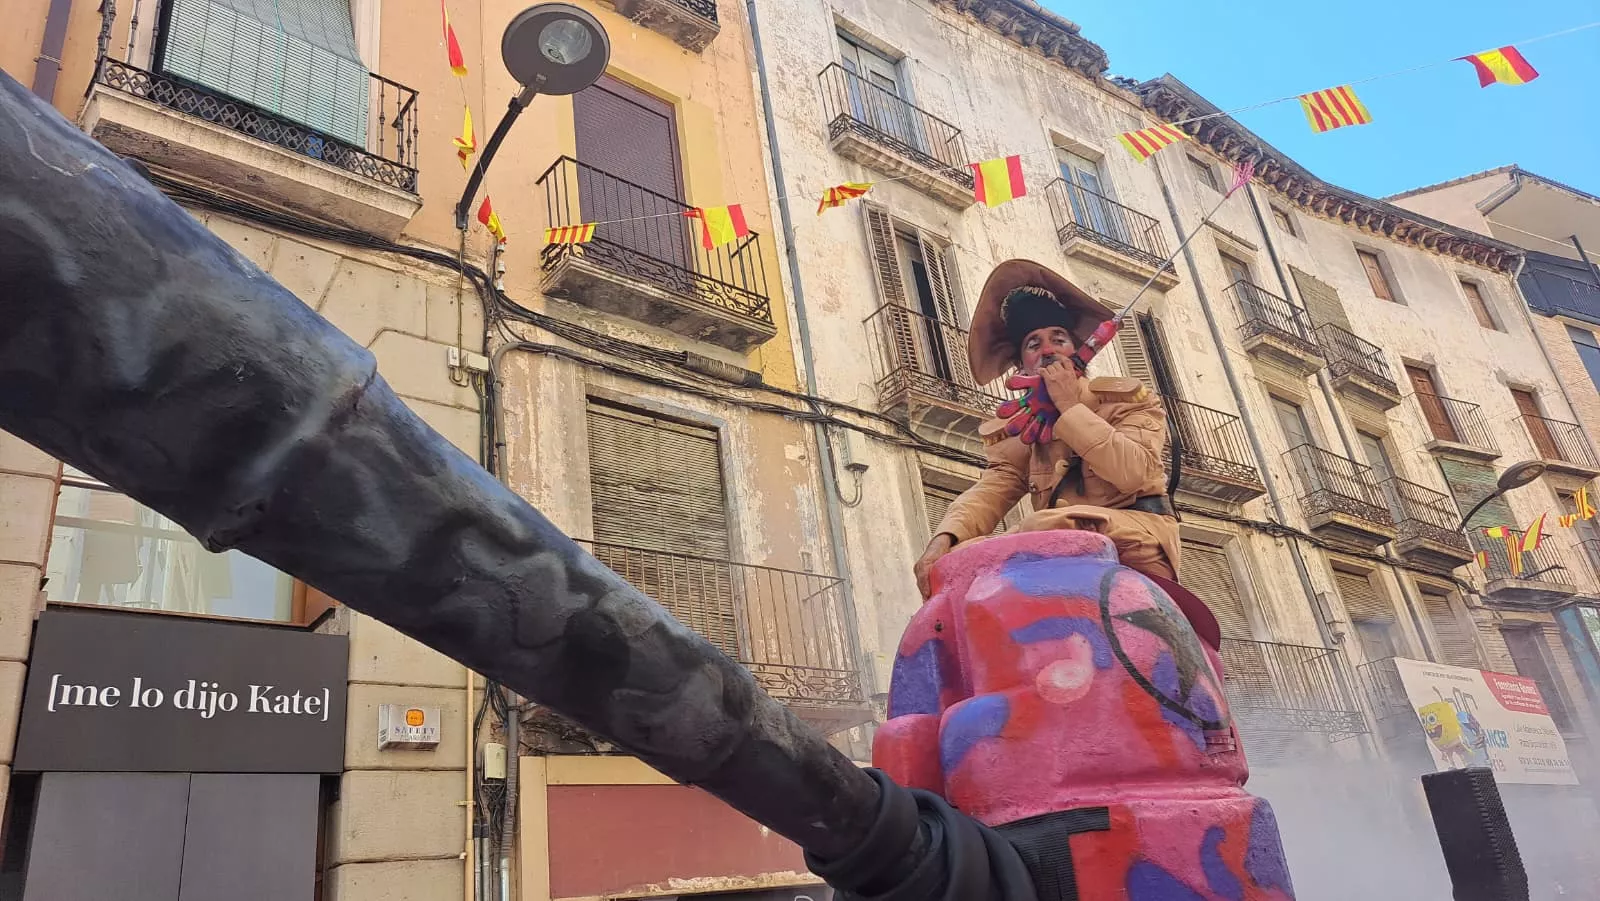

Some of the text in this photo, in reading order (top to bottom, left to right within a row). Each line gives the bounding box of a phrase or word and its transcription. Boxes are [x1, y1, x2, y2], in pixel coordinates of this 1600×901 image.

[48, 674, 330, 721] [me lo dijo Kate]
